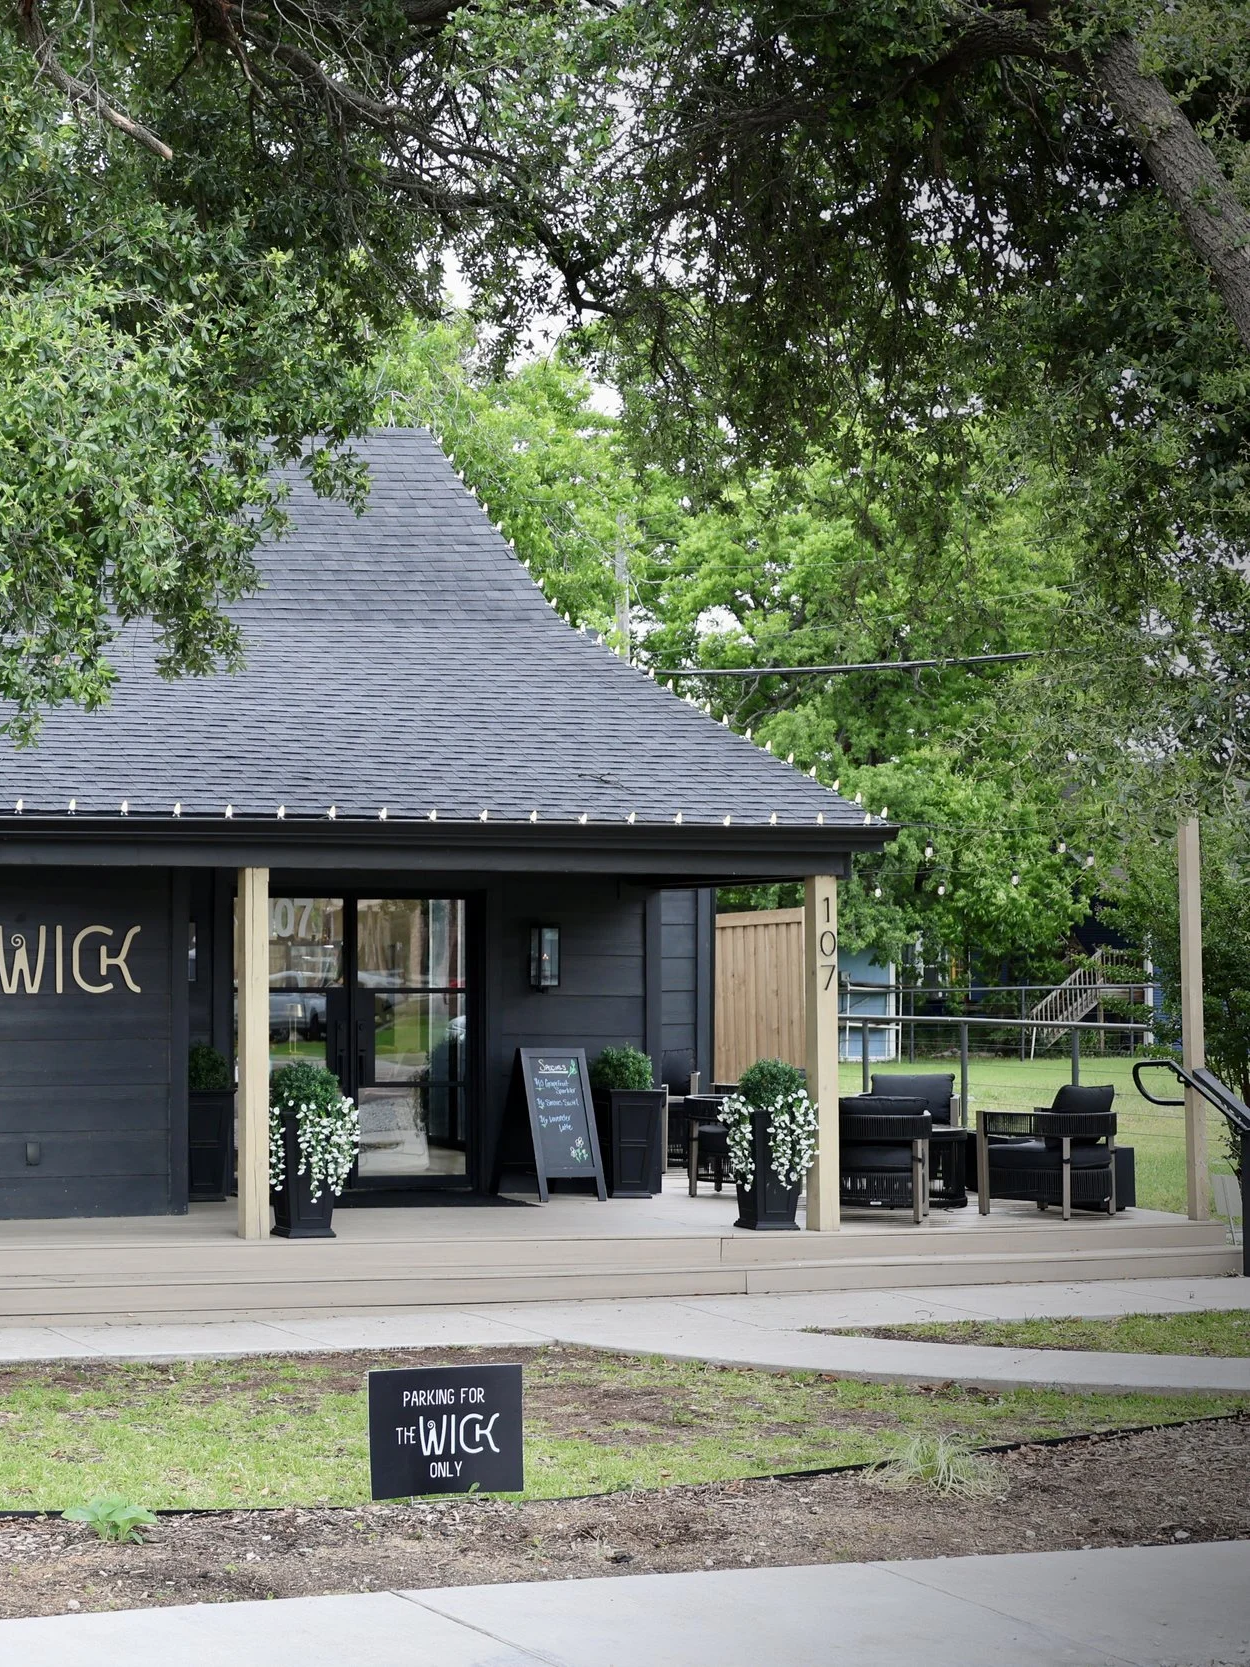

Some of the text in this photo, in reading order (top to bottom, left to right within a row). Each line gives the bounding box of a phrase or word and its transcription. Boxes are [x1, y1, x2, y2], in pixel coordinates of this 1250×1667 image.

[820, 896, 836, 991] 107
[403, 1387, 485, 1407] PARKING FOR
[395, 1412, 500, 1456] THE WICK
[429, 1461, 463, 1478] ONLY
